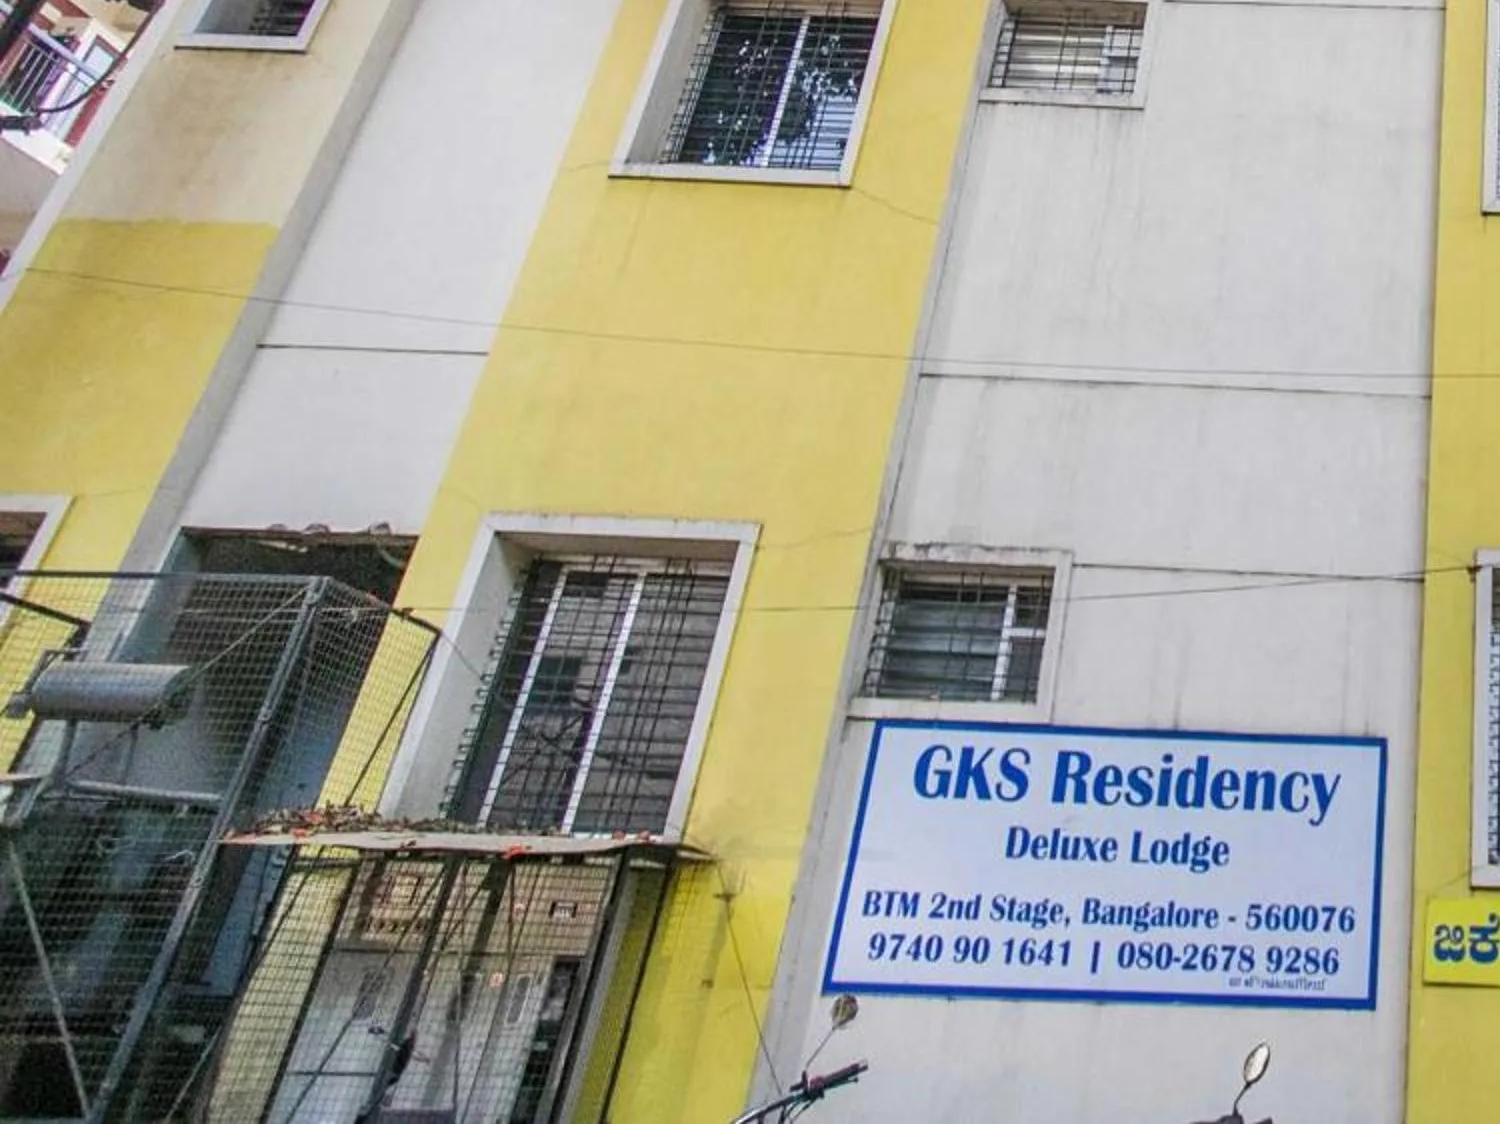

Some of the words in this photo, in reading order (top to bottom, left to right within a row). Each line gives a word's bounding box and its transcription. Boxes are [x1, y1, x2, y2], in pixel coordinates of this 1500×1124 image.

[913, 743, 1032, 802] GKS
[1050, 749, 1342, 827] Residency
[1004, 825, 1119, 864] Deluxe
[1130, 831, 1231, 874] Lodge
[861, 889, 922, 919] BTM
[927, 891, 983, 921] 2nd
[989, 893, 1071, 930] Stage,
[1081, 896, 1220, 934] Bangalore
[1245, 903, 1356, 934] 560076
[867, 931, 944, 963] 9740
[952, 935, 991, 965] 90
[1002, 937, 1072, 967] 1641
[1116, 941, 1256, 974] 080-2678
[1265, 945, 1340, 976] 9286
